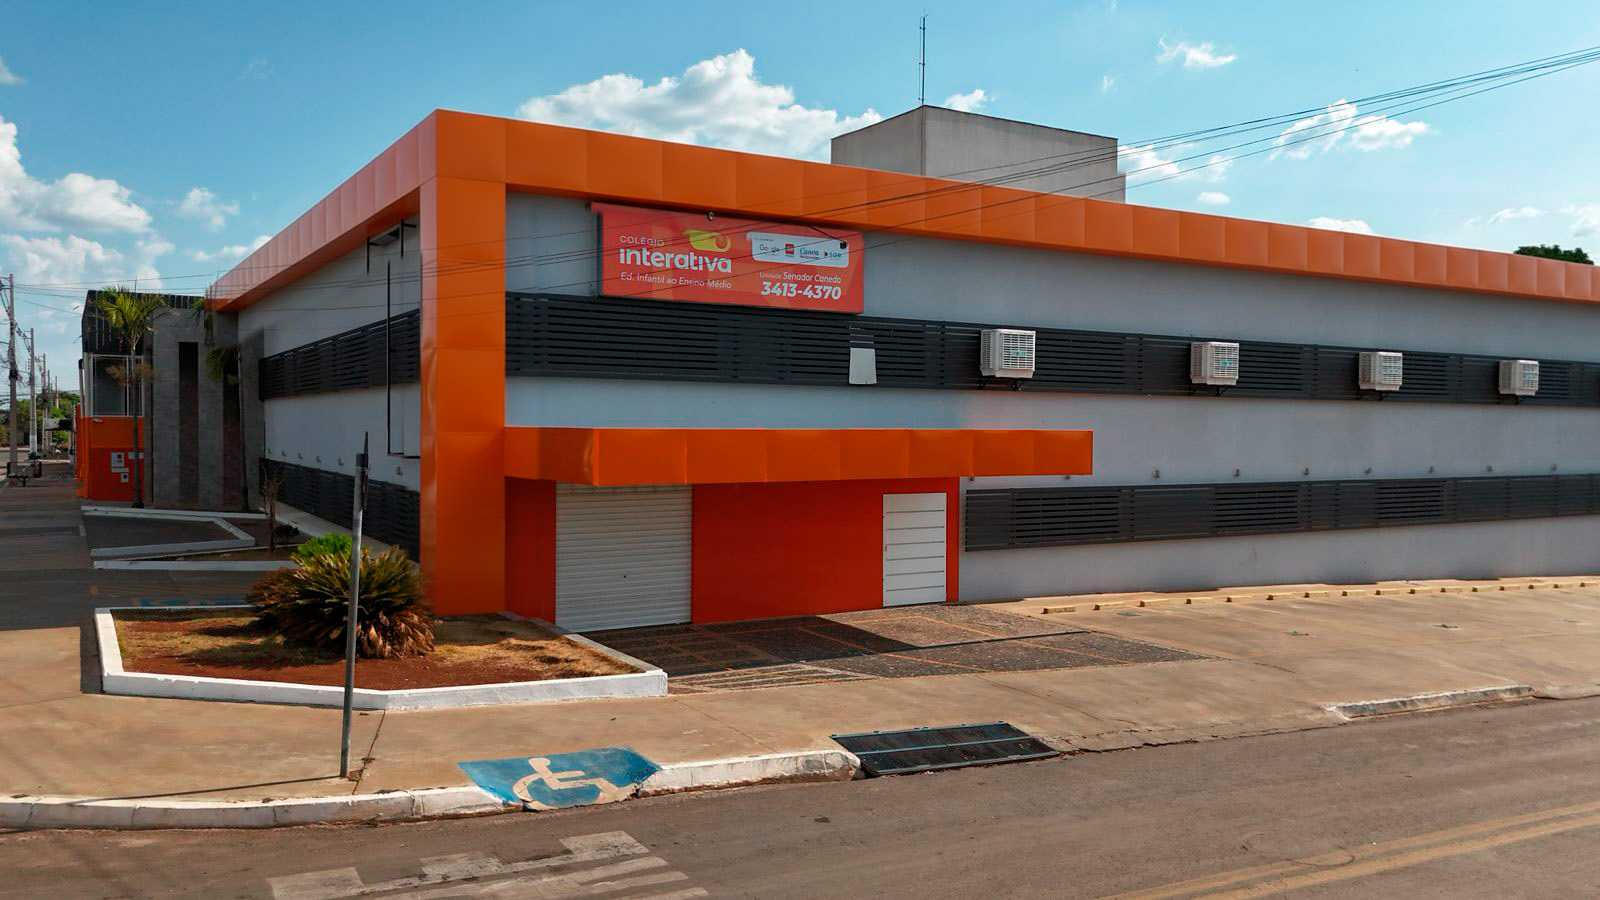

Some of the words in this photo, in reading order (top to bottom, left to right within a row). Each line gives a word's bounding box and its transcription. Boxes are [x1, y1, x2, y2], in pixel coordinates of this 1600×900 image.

[619, 247, 732, 273] interativa
[637, 272, 665, 284] Infantil
[667, 277, 677, 285] ao
[707, 279, 732, 289] Médio
[783, 271, 813, 282] Senador
[815, 274, 842, 284] Canedo
[761, 281, 842, 300] 3413-4370
